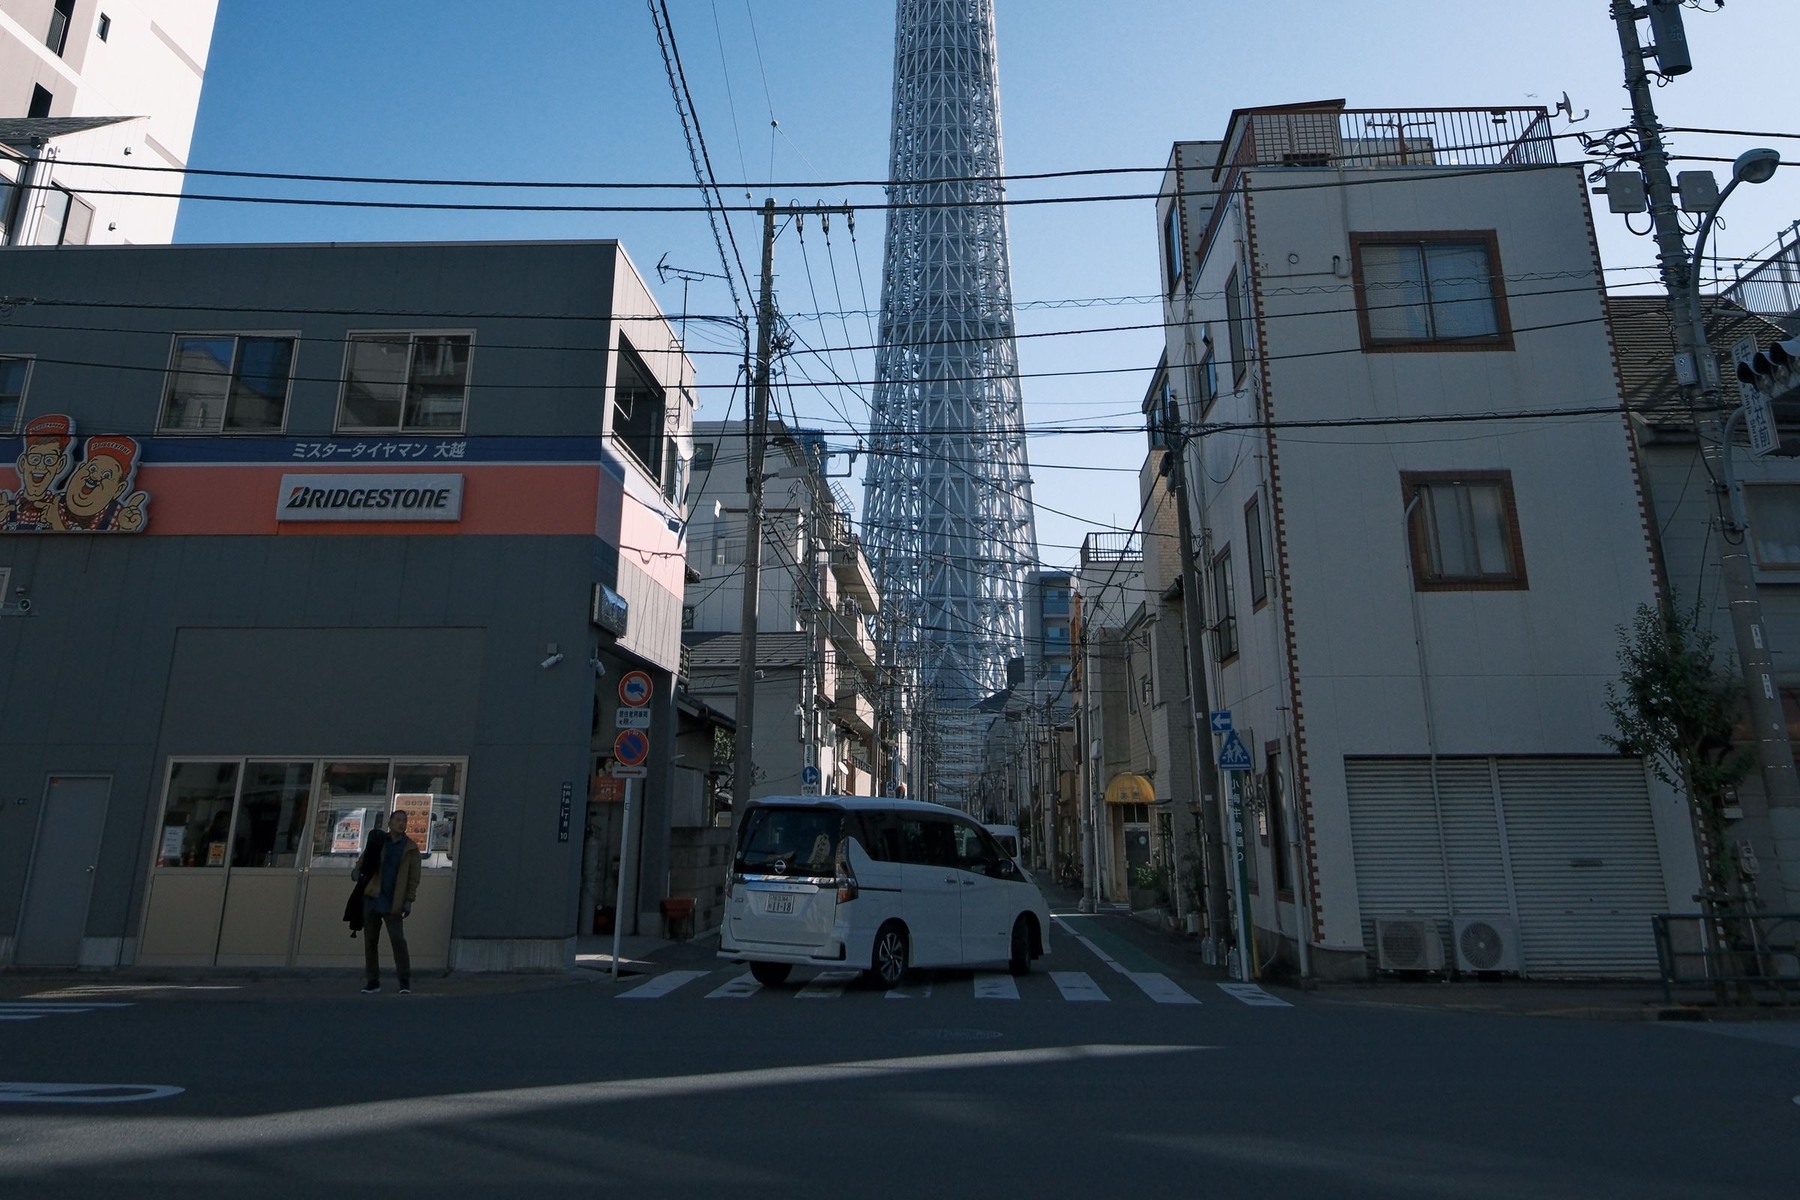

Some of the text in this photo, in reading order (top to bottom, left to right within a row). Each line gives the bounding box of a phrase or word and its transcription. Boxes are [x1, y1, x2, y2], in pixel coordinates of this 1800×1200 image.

[1740, 343, 1771, 448] 牛神社前
[292, 441, 467, 459] ミスタータイヤマン 大越
[286, 486, 450, 509] BRIDGESTONE
